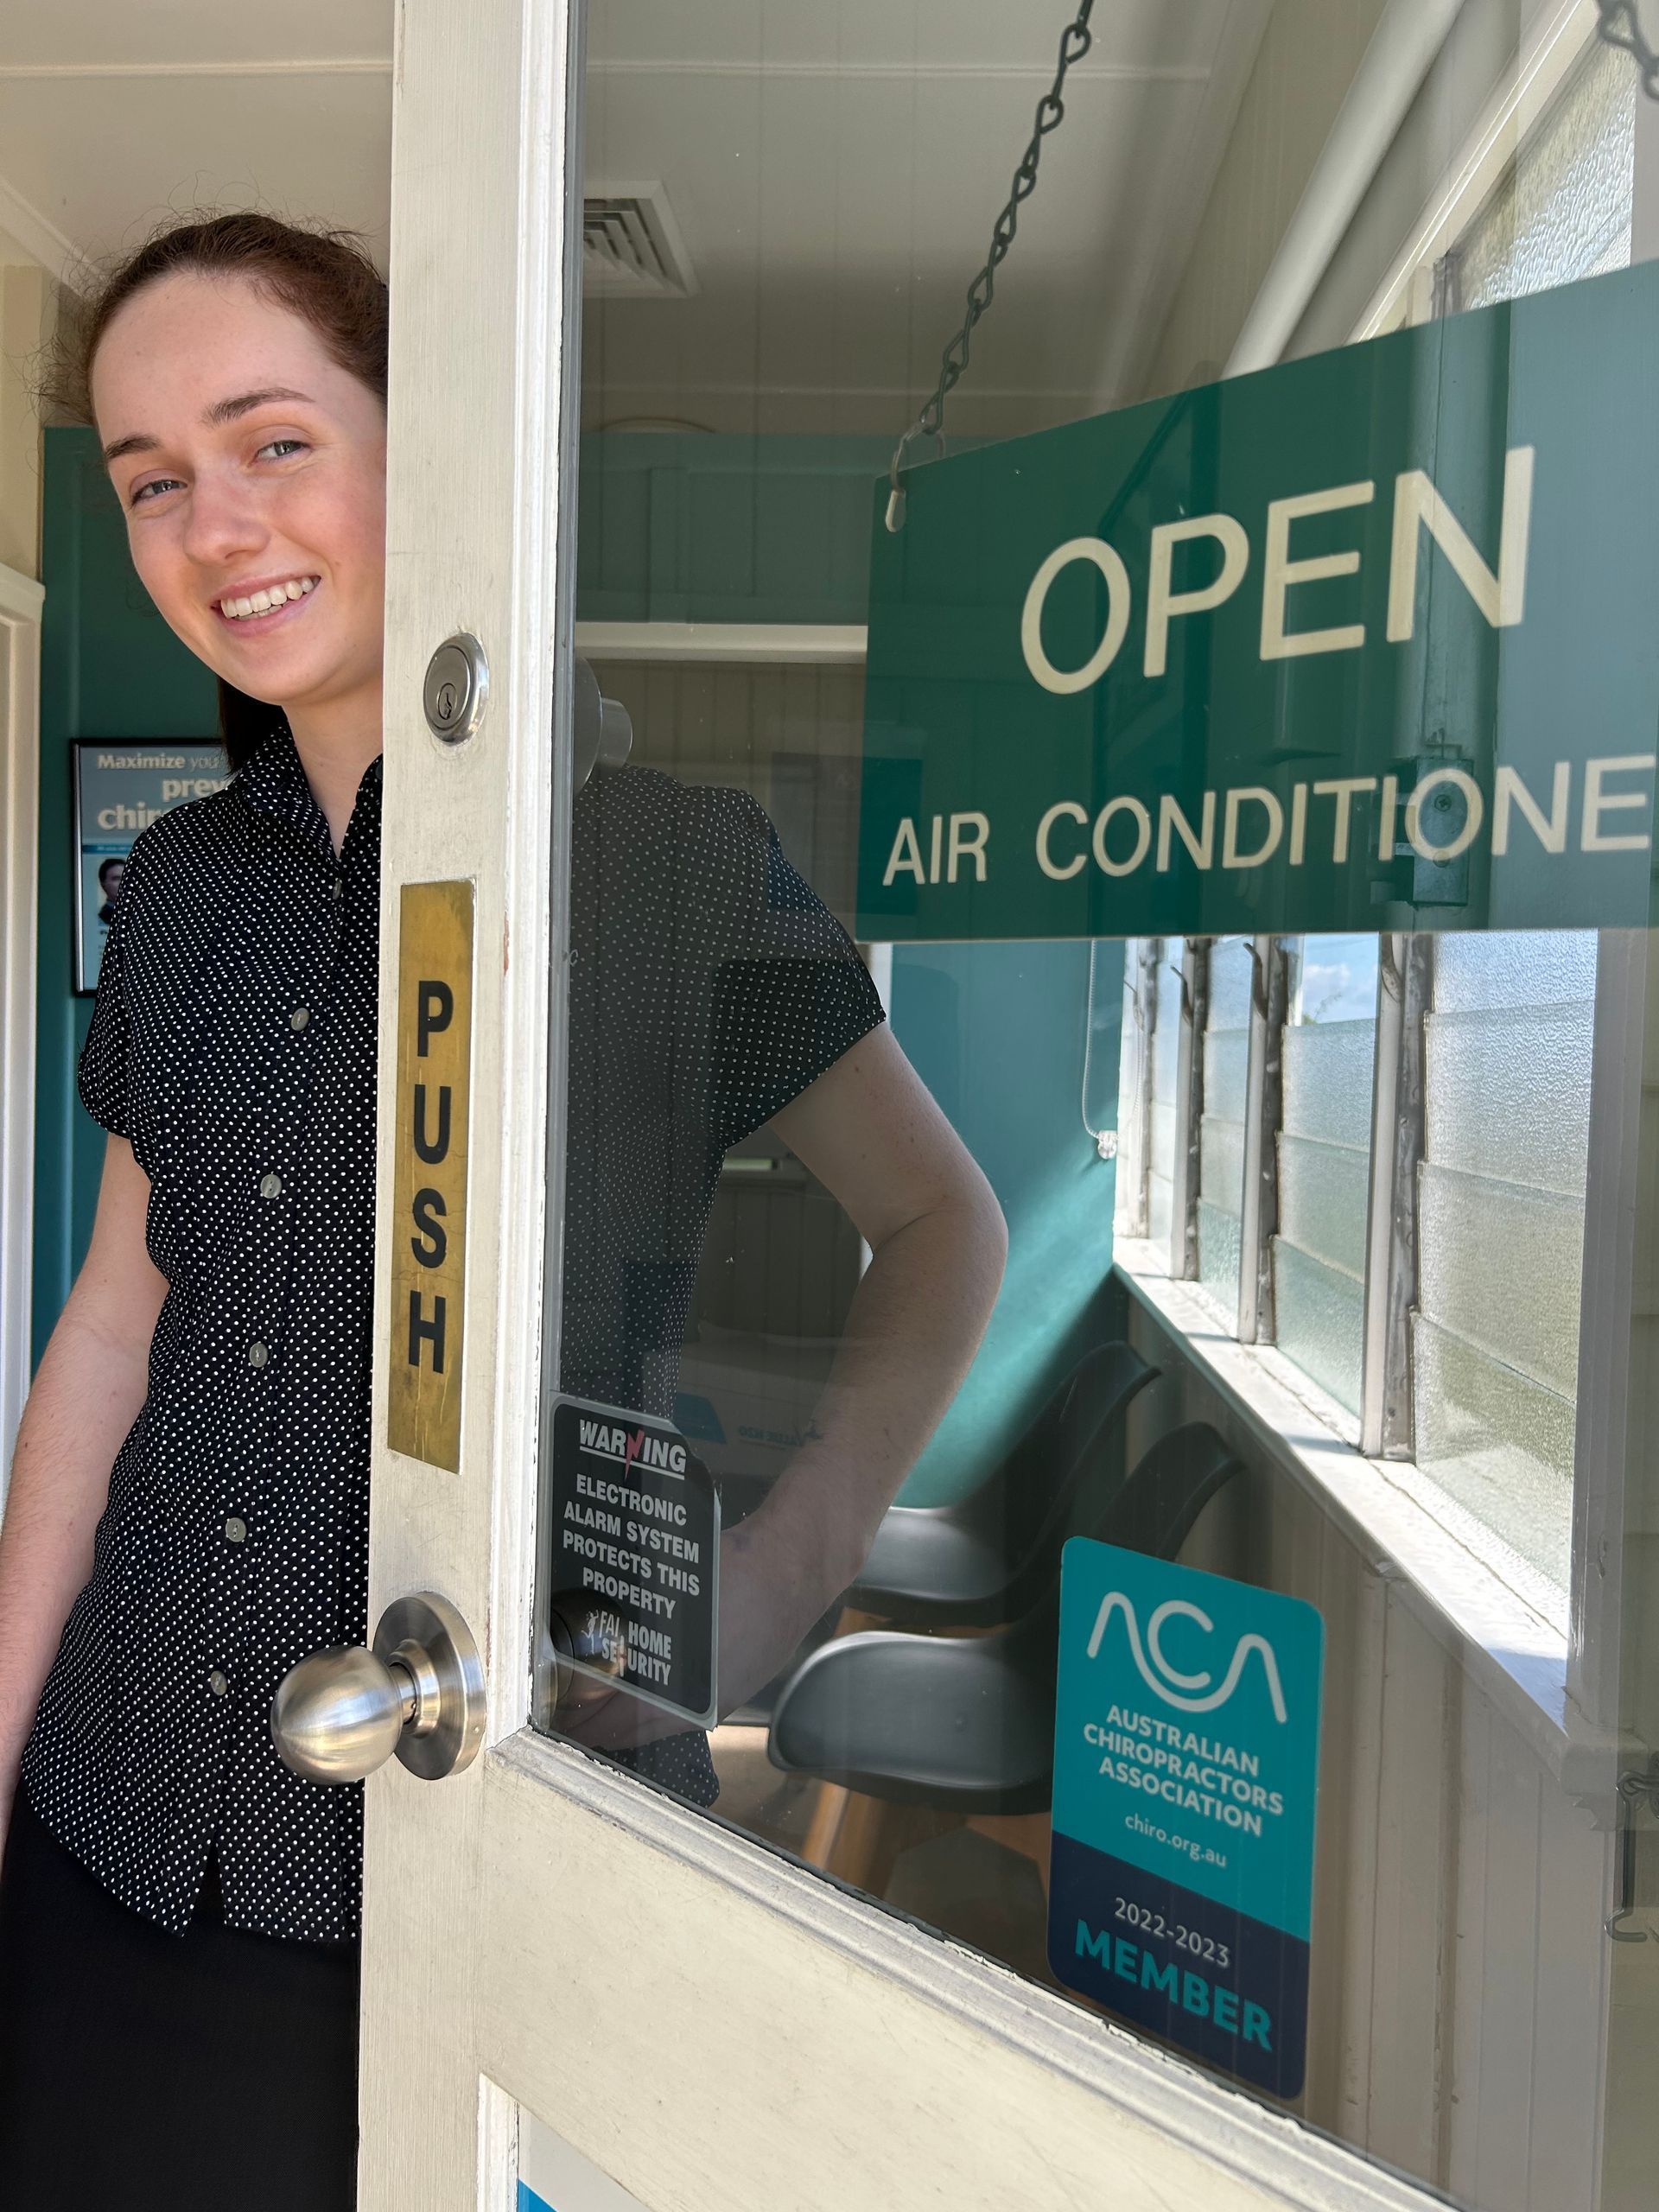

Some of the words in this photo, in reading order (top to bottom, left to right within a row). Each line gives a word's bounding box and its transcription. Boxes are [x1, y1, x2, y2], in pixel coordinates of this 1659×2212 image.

[1020, 445, 1535, 695] OPEN
[97, 753, 185, 770] Maximize
[882, 810, 990, 887] AIR
[1036, 753, 1656, 881] CONDITIONE
[409, 980, 454, 1374] PUSH
[580, 1418, 687, 1478] WARNING
[563, 1501, 621, 1537] ALARM
[626, 1521, 699, 1564] SYSTEM
[576, 1473, 688, 1527] ELECTRONIC
[563, 1529, 652, 1580] PROTECTS
[658, 1562, 700, 1596] THIS
[582, 1567, 677, 1619] PROPERTY
[628, 1620, 671, 1660] HOME
[1086, 1591, 1287, 1723] ACA
[1084, 1723, 1284, 1815] CHIROPRACTORS
[1107, 1704, 1260, 1777] AUSTRALIAN
[1098, 1758, 1262, 1838] ASSOCIATION
[1125, 1812, 1227, 1869] chiro.org.au
[1115, 1897, 1230, 1967] 2022-2023
[1074, 1918, 1274, 2052] MEMBER
